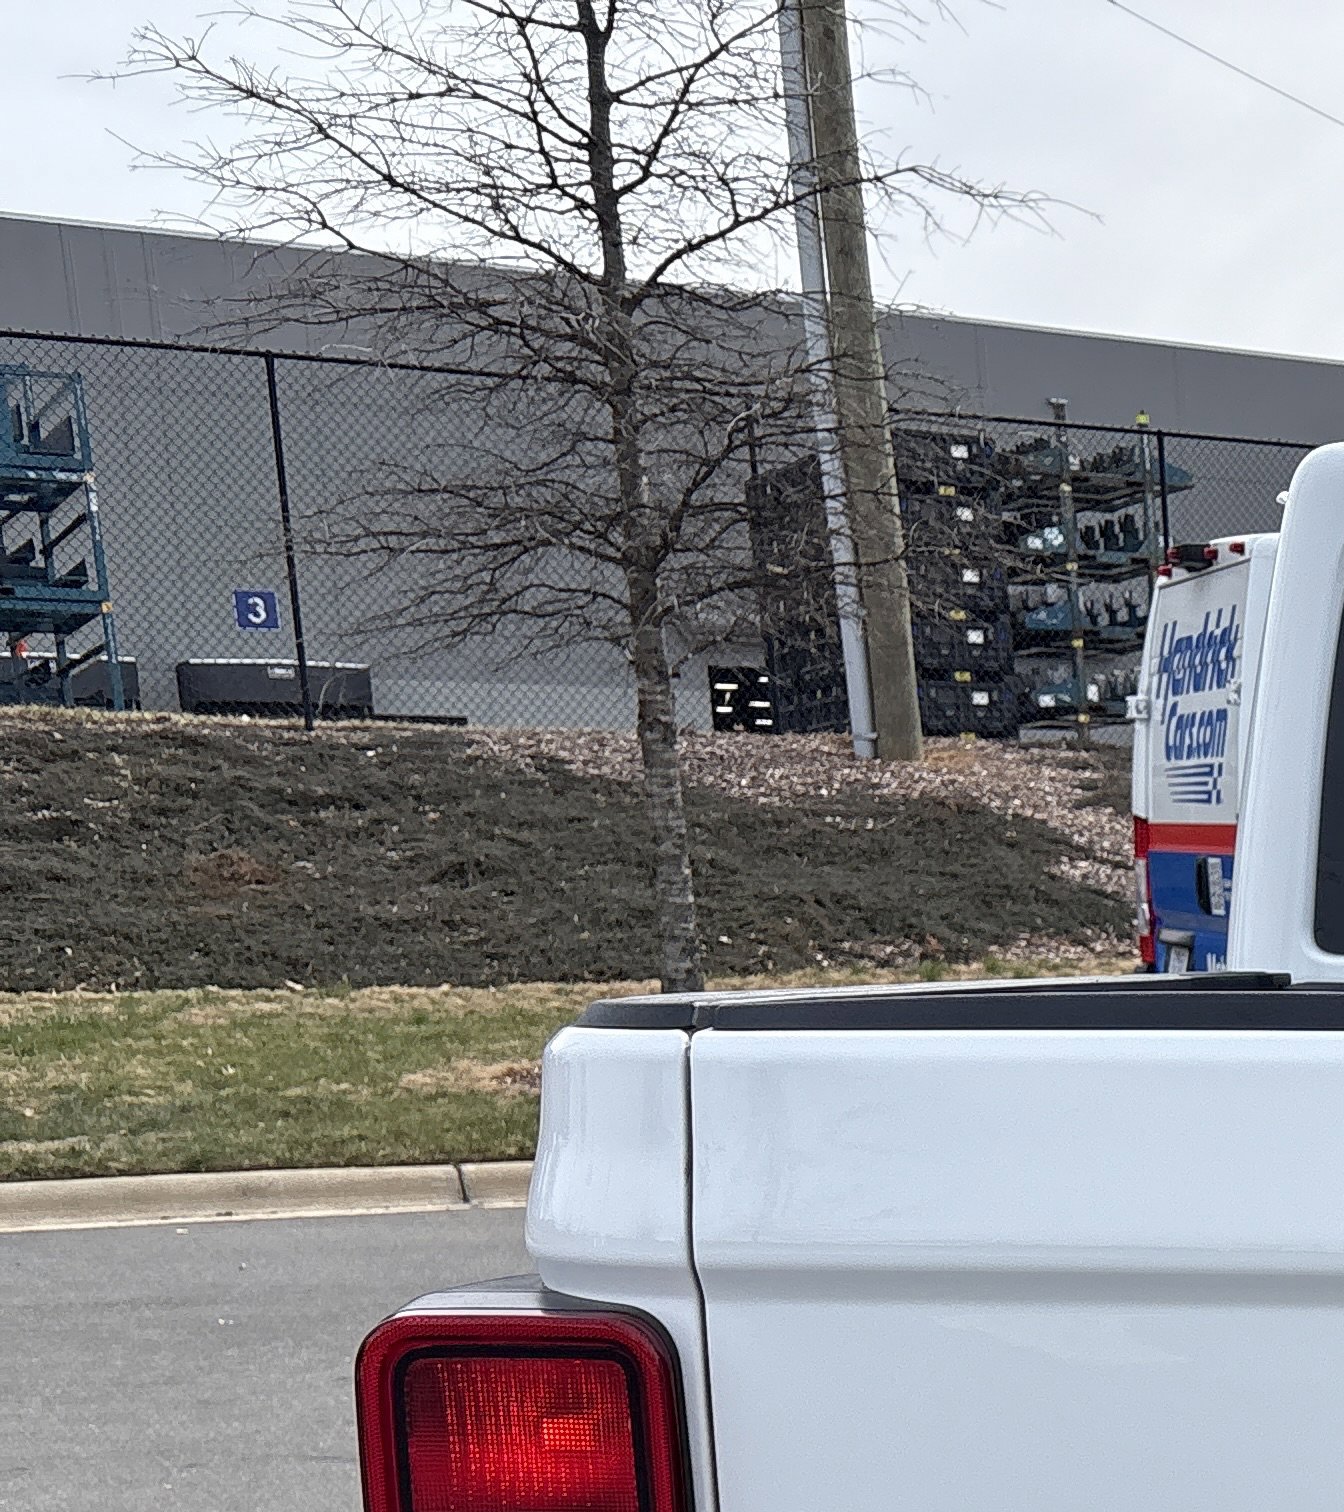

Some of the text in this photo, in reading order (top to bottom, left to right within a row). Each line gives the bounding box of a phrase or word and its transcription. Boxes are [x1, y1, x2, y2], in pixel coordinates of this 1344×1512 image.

[247, 596, 267, 625] 3
[1155, 604, 1241, 726] Hendrick
[1165, 700, 1229, 763] Cars.com
